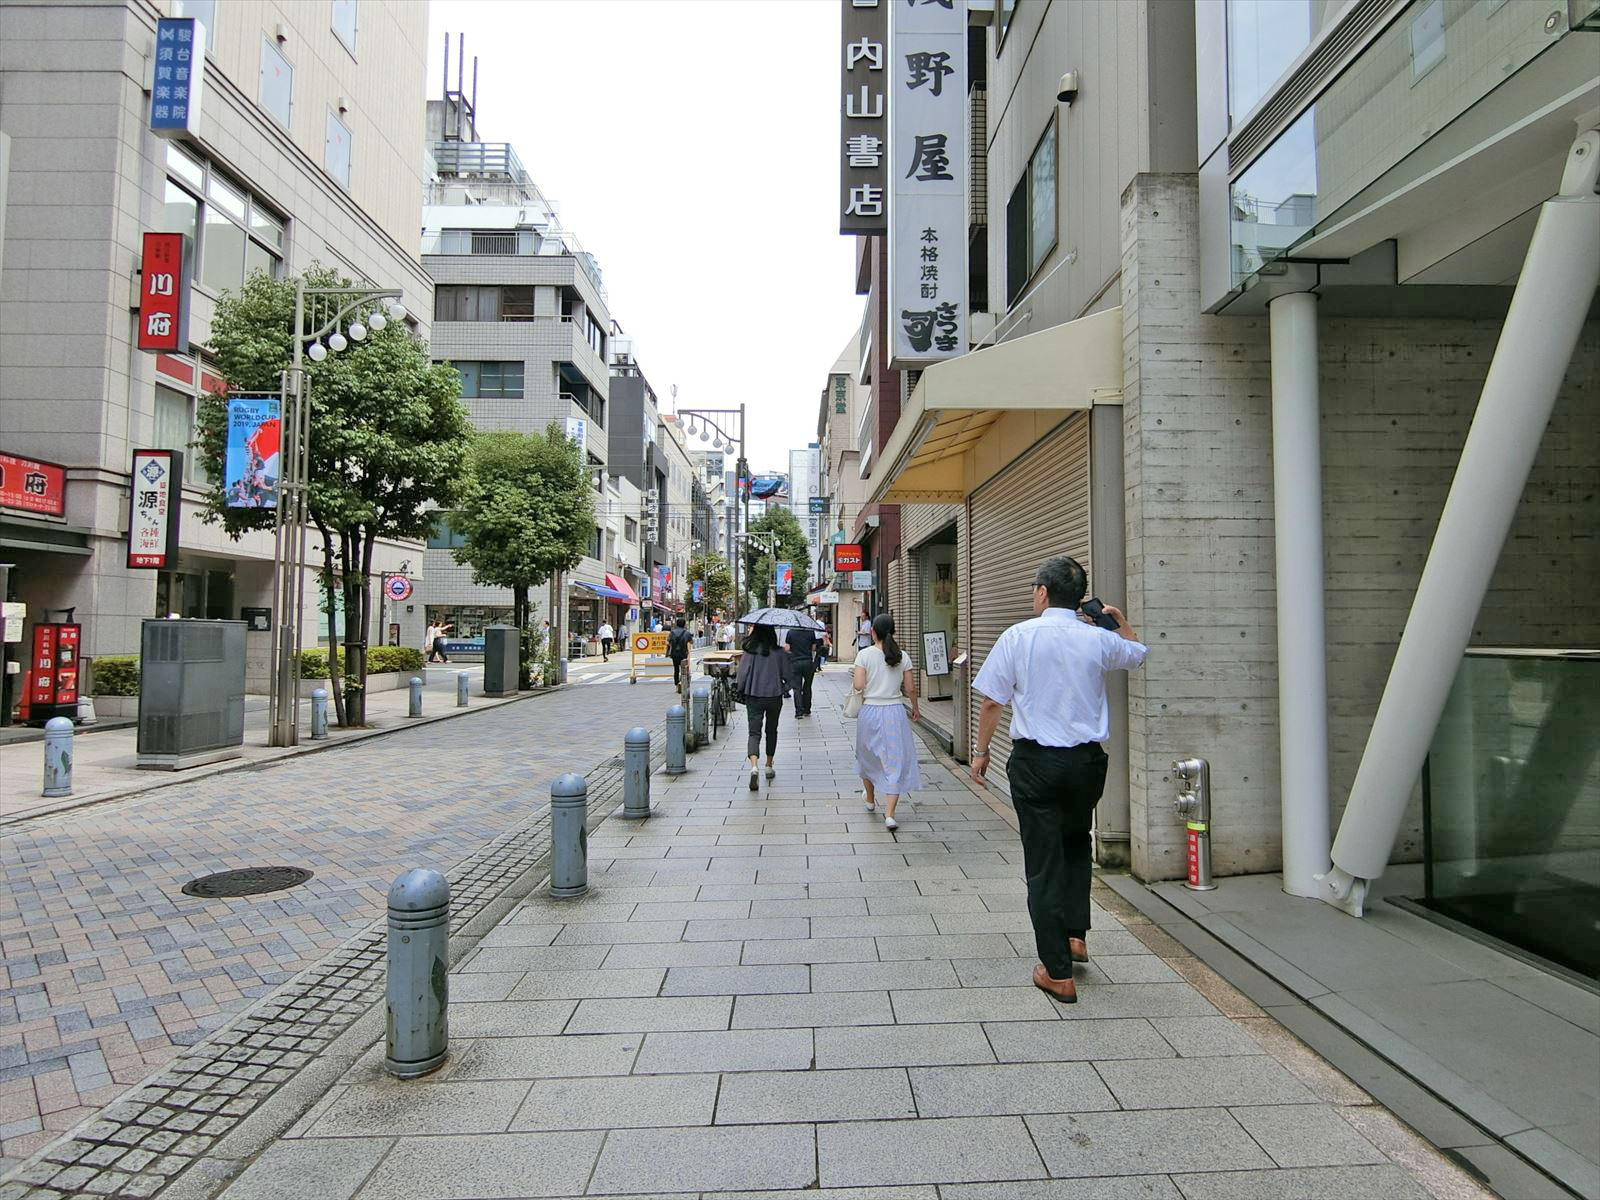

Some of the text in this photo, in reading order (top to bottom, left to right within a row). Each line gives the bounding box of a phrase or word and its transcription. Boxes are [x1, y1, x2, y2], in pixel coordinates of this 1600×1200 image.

[172, 28, 192, 119] 駿台音楽院
[902, 0, 954, 182] 野屋
[845, 36, 883, 217] 内山書店
[147, 273, 174, 336] 川府
[920, 227, 939, 300] 本格焼酎
[233, 406, 260, 414] RUGBY
